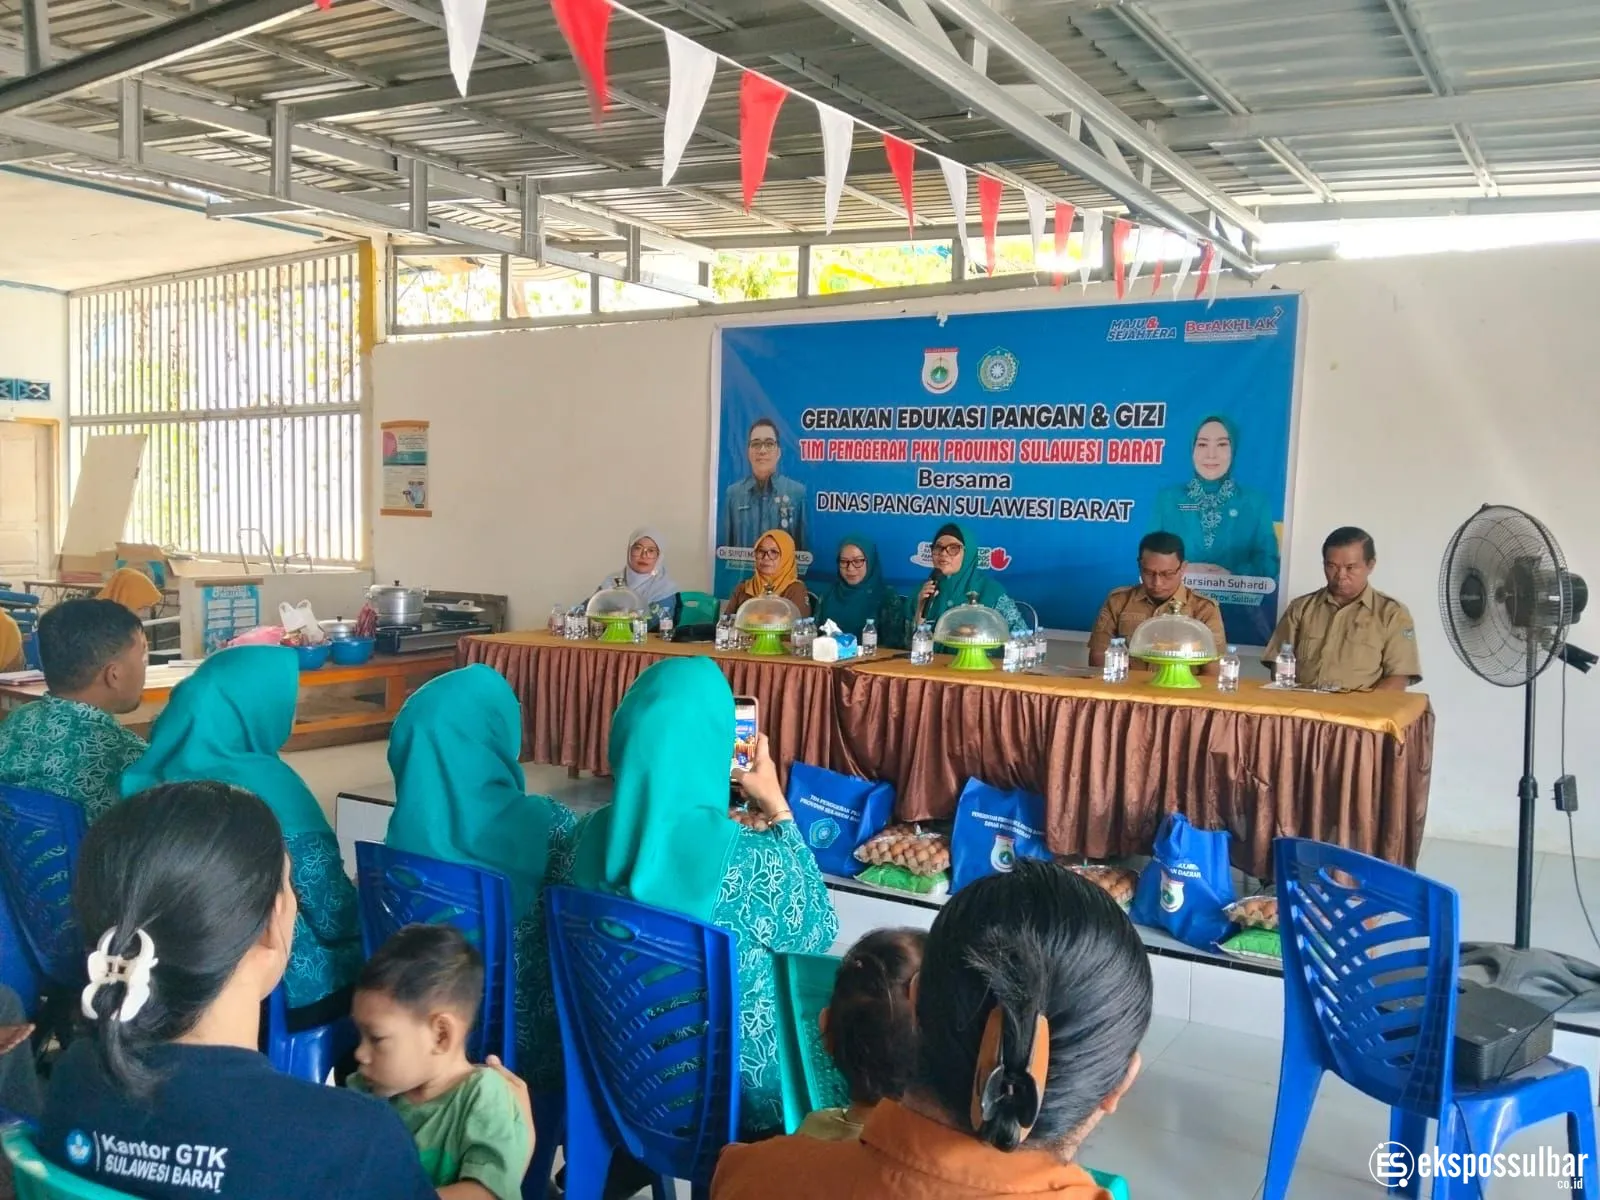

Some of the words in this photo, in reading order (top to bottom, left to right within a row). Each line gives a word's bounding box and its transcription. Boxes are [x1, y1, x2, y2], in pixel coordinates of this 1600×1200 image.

[1107, 328, 1177, 341] SEJAHTERA
[1185, 317, 1277, 333] BerAKHLAK
[802, 408, 893, 431] GERAKAN
[897, 406, 986, 429] EDUKASI
[991, 404, 1085, 429] PANGAN
[1090, 403, 1110, 429] &
[1115, 402, 1166, 429] GIZI
[800, 439, 824, 461] TIM
[827, 439, 907, 462] PENGGERAK
[911, 439, 940, 463] PKK
[944, 439, 1015, 464] PROVINSI
[1020, 439, 1102, 464] SULAWESI
[1107, 439, 1165, 464] BARAT
[918, 467, 1012, 490] Bersama
[817, 491, 870, 513] DINAS
[873, 493, 951, 516] PANGAN
[955, 496, 1054, 519] SULAWESI
[1059, 499, 1135, 522] BARAT
[1227, 578, 1268, 591] Suhardi
[101, 1133, 170, 1160] Kantor
[175, 1144, 229, 1169] GTK
[105, 1154, 169, 1183] SULAWESI
[172, 1166, 225, 1191] BARAT
